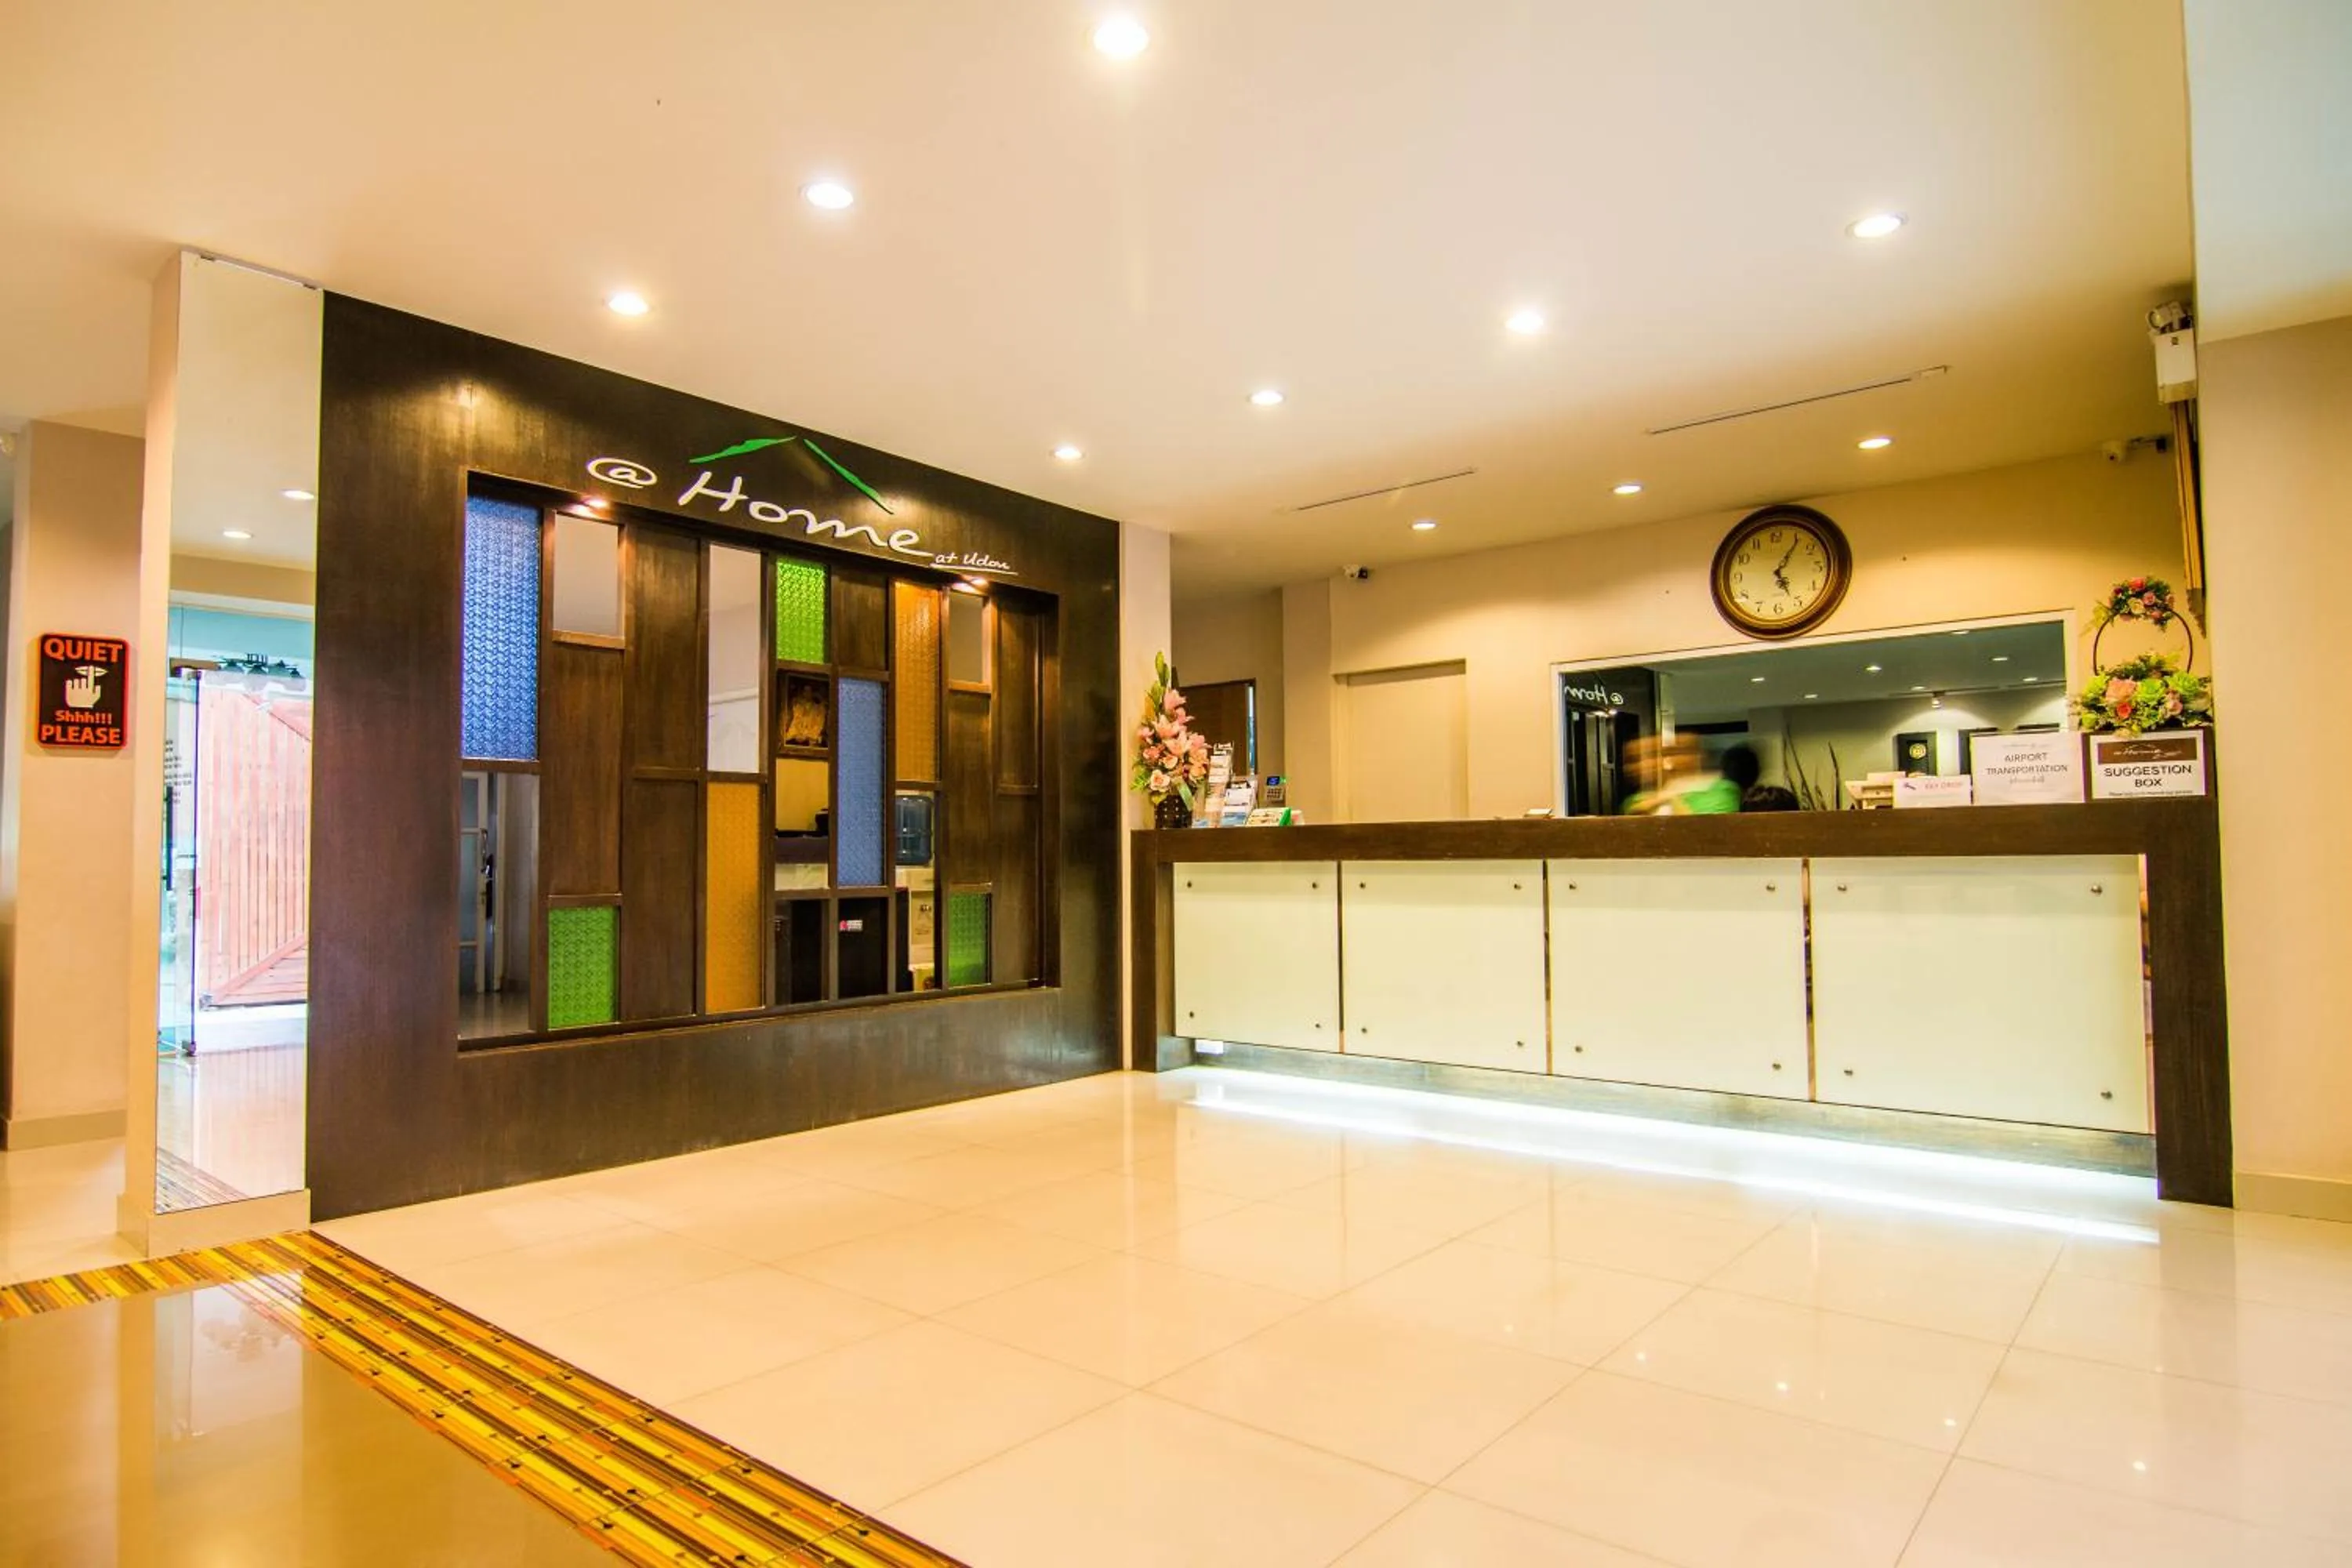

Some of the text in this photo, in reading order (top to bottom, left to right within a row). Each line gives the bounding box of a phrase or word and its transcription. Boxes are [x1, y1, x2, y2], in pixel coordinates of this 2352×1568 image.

[678, 470, 934, 557] Home
[935, 552, 958, 564] at
[963, 552, 1011, 570] Udon
[1738, 553, 1751, 565] 10
[1773, 603, 1784, 615] 6
[44, 637, 123, 662] QUIET
[42, 724, 121, 744] PLEASE
[2004, 753, 2049, 762] AIRPORT
[1985, 764, 2068, 775] TRANSPORTATION
[2103, 764, 2192, 777] SUGGESTION
[2134, 779, 2162, 788] BOX
